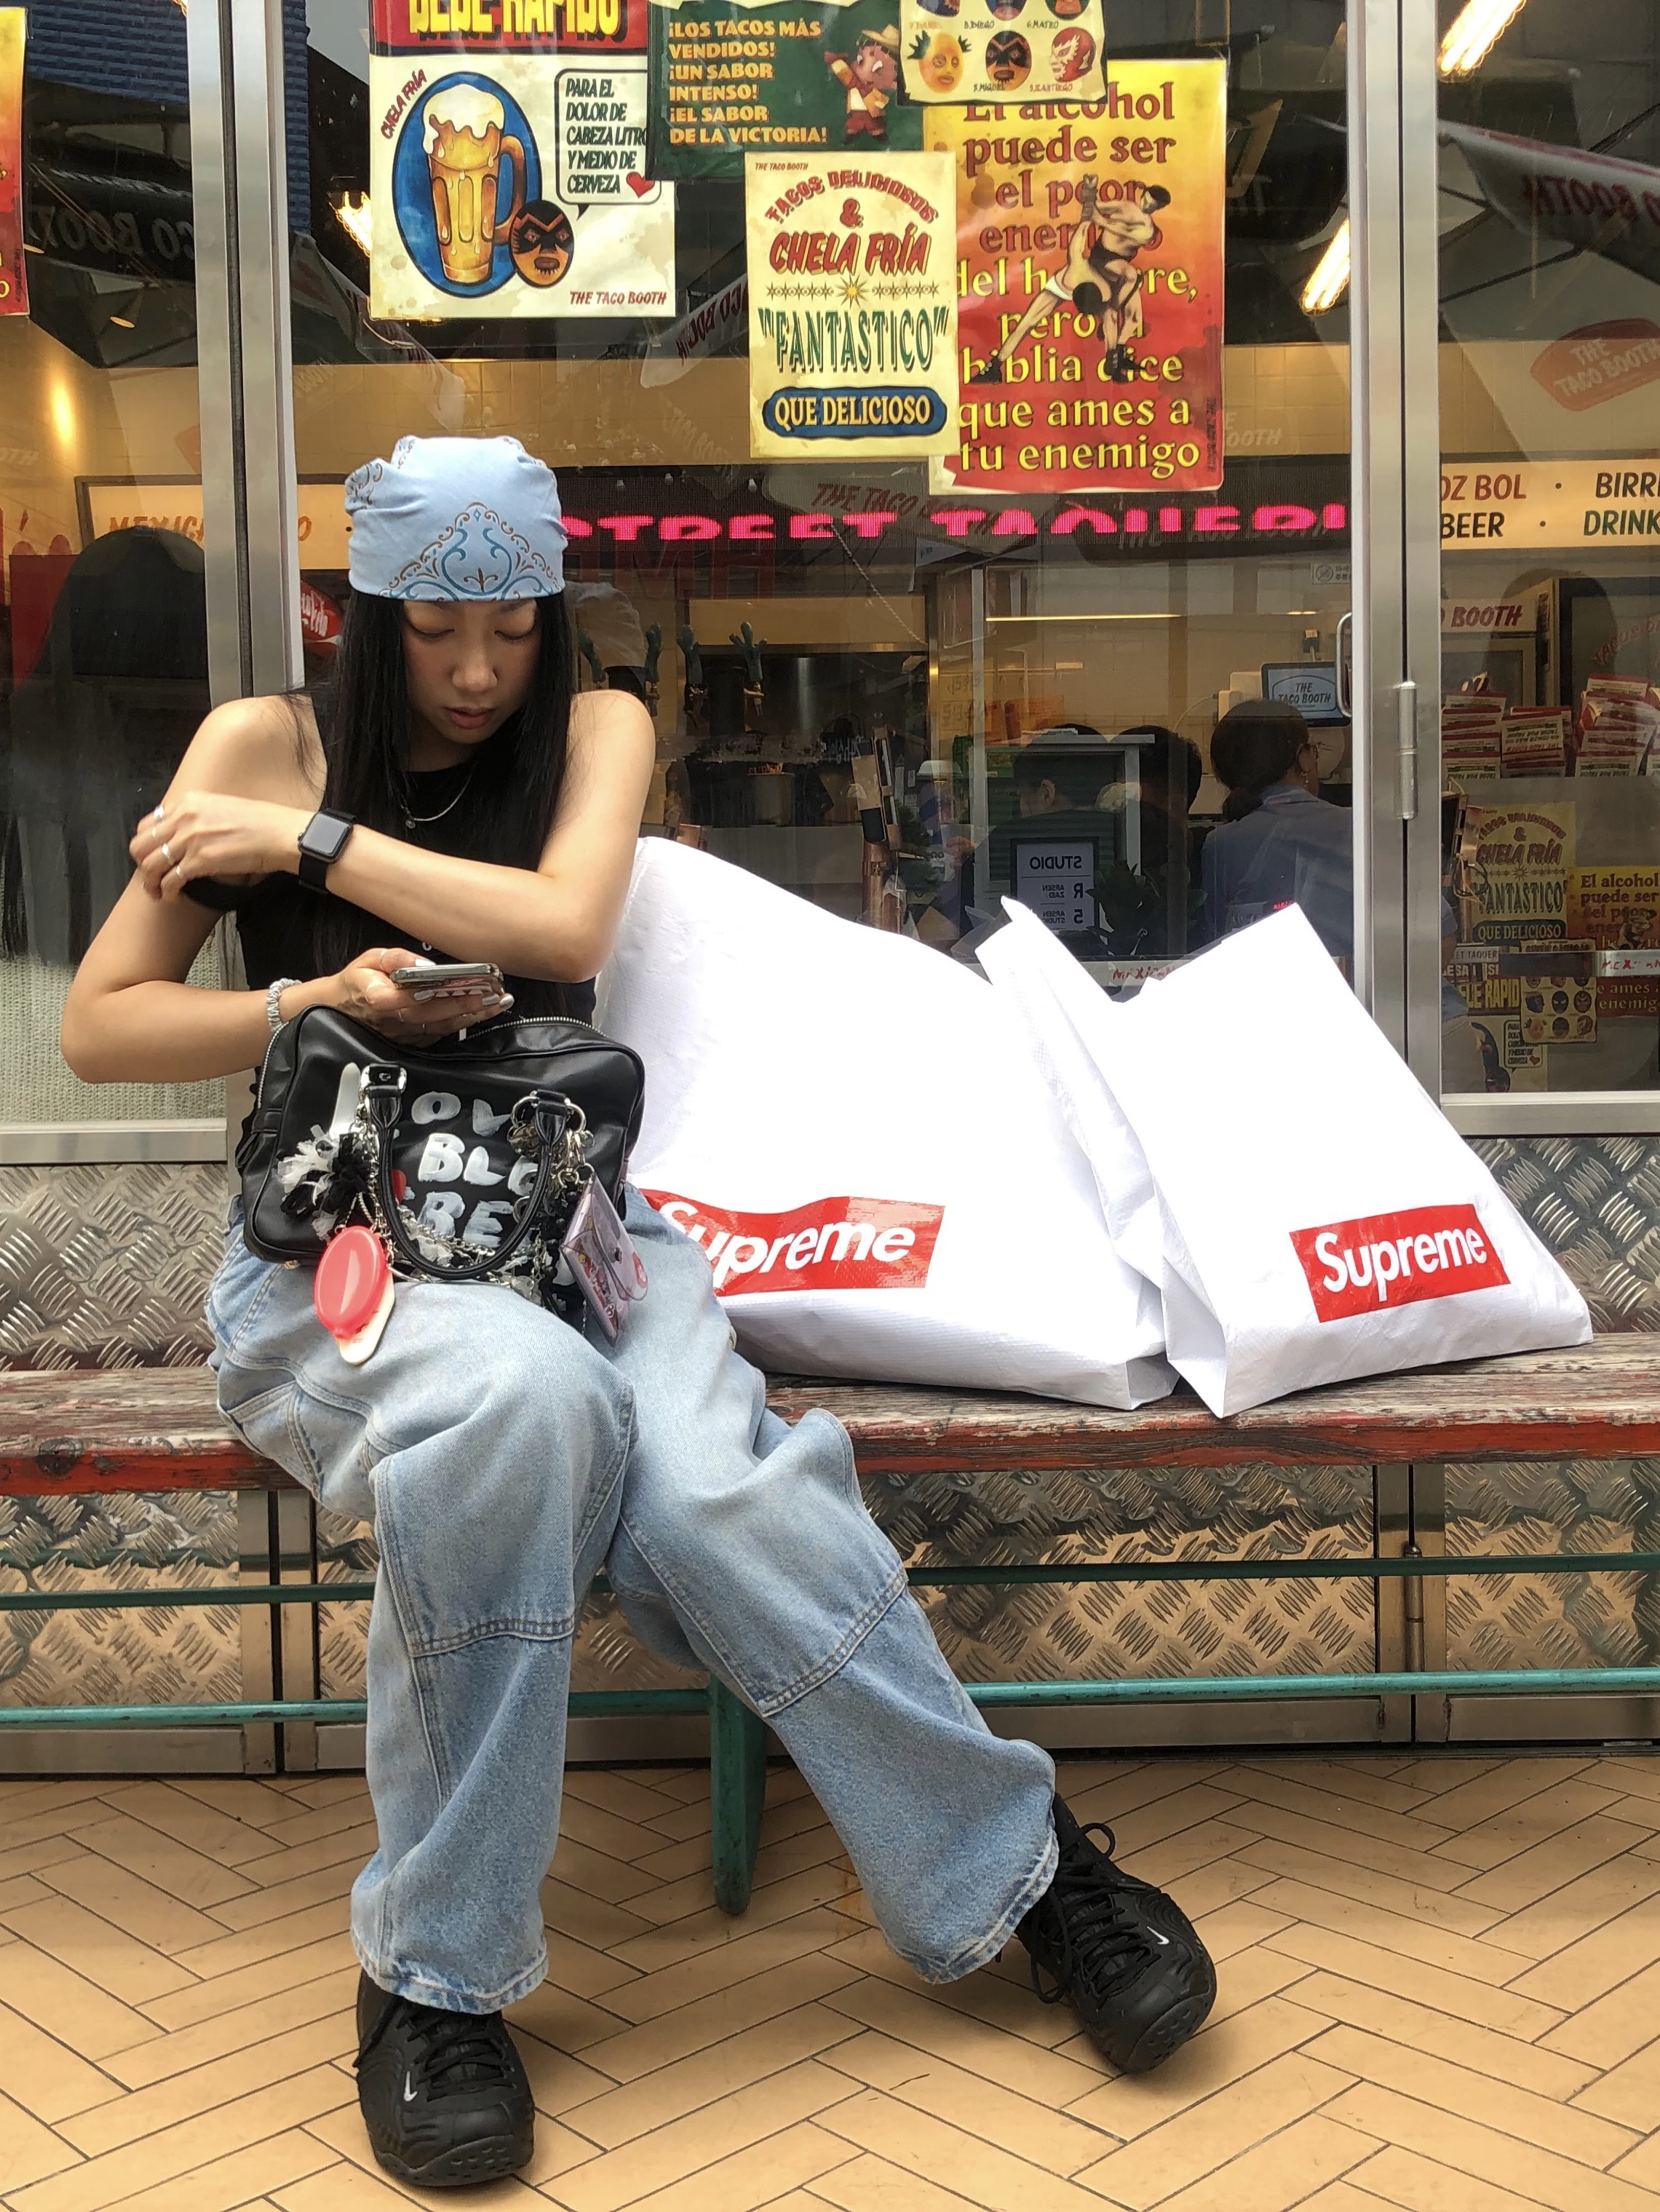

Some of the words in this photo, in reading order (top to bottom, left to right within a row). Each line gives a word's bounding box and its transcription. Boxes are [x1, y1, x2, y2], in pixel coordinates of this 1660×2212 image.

[715, 20, 776, 38] TACOS
[779, 18, 822, 37] MÁS
[669, 41, 777, 60] VENDIDOS!
[707, 63, 774, 80] SABOR
[565, 78, 597, 98] PARA
[599, 78, 615, 98] EL
[669, 84, 760, 103] INTENSO!
[380, 95, 408, 140] CHELA
[565, 102, 608, 122] DOLOR
[609, 102, 628, 122] DE
[702, 105, 770, 123] SABOR
[565, 127, 614, 146] CABEZA
[670, 128, 696, 145] DE
[700, 128, 723, 145] LA
[728, 127, 828, 145] VICTORIA!
[568, 151, 579, 170] Y
[577, 151, 617, 170] MEDIO
[619, 151, 637, 170] DE
[964, 125, 1097, 178] puede
[1109, 136, 1177, 164] ser
[755, 162, 769, 171] THE
[769, 162, 787, 171] TACO
[787, 162, 809, 171] BOOTH
[567, 175, 621, 194] CERVEZA
[995, 169, 1033, 209] el
[763, 175, 824, 226] TACOS
[827, 169, 940, 224] DELICIOSOS
[839, 197, 865, 229] &
[769, 231, 862, 276] CHELA
[864, 222, 933, 277] FRÍA
[570, 291, 595, 306] THE
[596, 291, 626, 306] TACO
[627, 290, 668, 306] BOOTH
[1000, 312, 1095, 341] pero
[963, 346, 1082, 384] biblia
[774, 396, 817, 432] QUE
[822, 394, 932, 427] DELICIOSO
[958, 397, 1034, 439] que
[1056, 397, 1154, 427] ames
[1169, 397, 1190, 426] a
[960, 440, 1004, 472] tu
[1018, 438, 1201, 479] enemigo
[811, 483, 862, 512] THE
[1474, 474, 1527, 502] BOL
[1441, 512, 1506, 539] BEER
[1450, 604, 1523, 627] BOOTH
[1295, 682, 1313, 693] THE
[1278, 694, 1300, 704] TACO
[1301, 692, 1332, 704] BOOTH
[1581, 873, 1597, 888] El
[1601, 872, 1659, 888] alcohol
[1580, 888, 1630, 908] puede
[1634, 892, 1659, 903] ser
[1477, 924, 1502, 941] QUE
[1503, 923, 1562, 940] DELICIOSO
[1468, 950, 1498, 959] TAQUER
[1610, 984, 1651, 994] ames
[1599, 996, 1659, 1013] enemig
[659, 1201, 916, 1290] Supreme
[1314, 1226, 1488, 1304] Supreme
